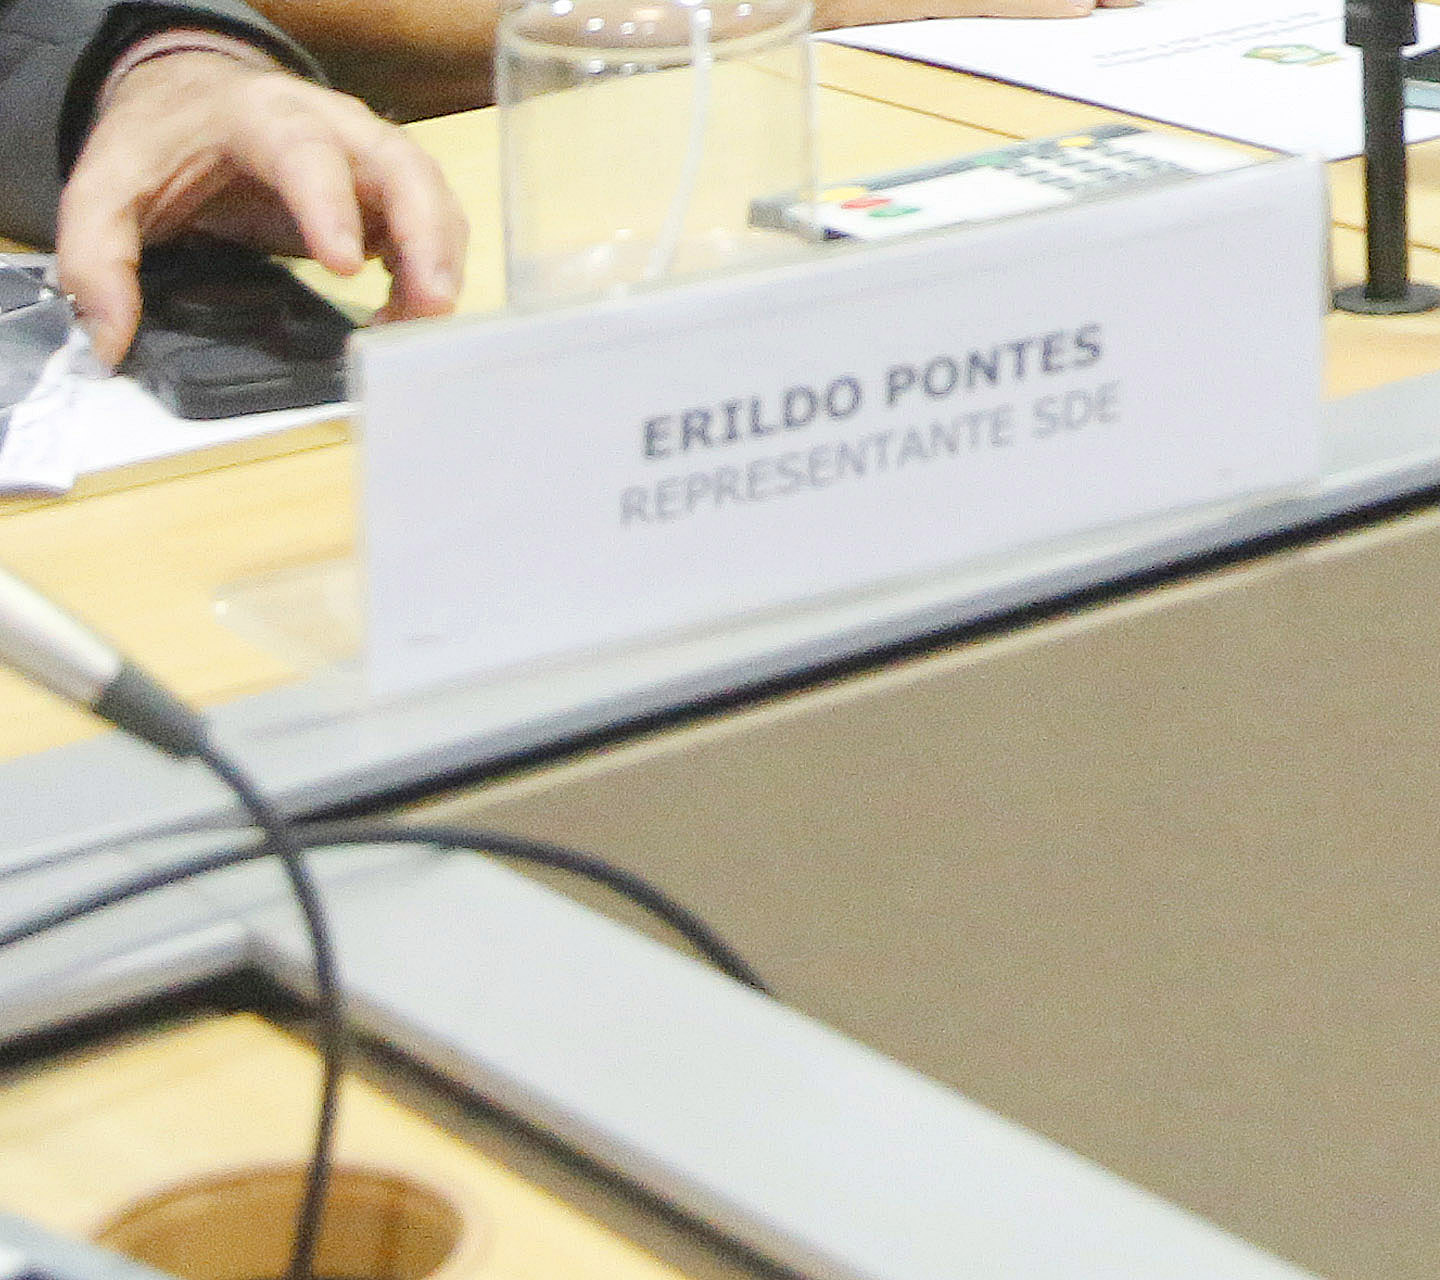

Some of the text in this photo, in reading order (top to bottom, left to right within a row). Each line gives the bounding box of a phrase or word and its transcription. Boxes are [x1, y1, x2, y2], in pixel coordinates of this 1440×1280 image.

[619, 380, 1121, 528] REPRESENTANTE SDE
[641, 322, 1103, 461] ERILDO PONTES
